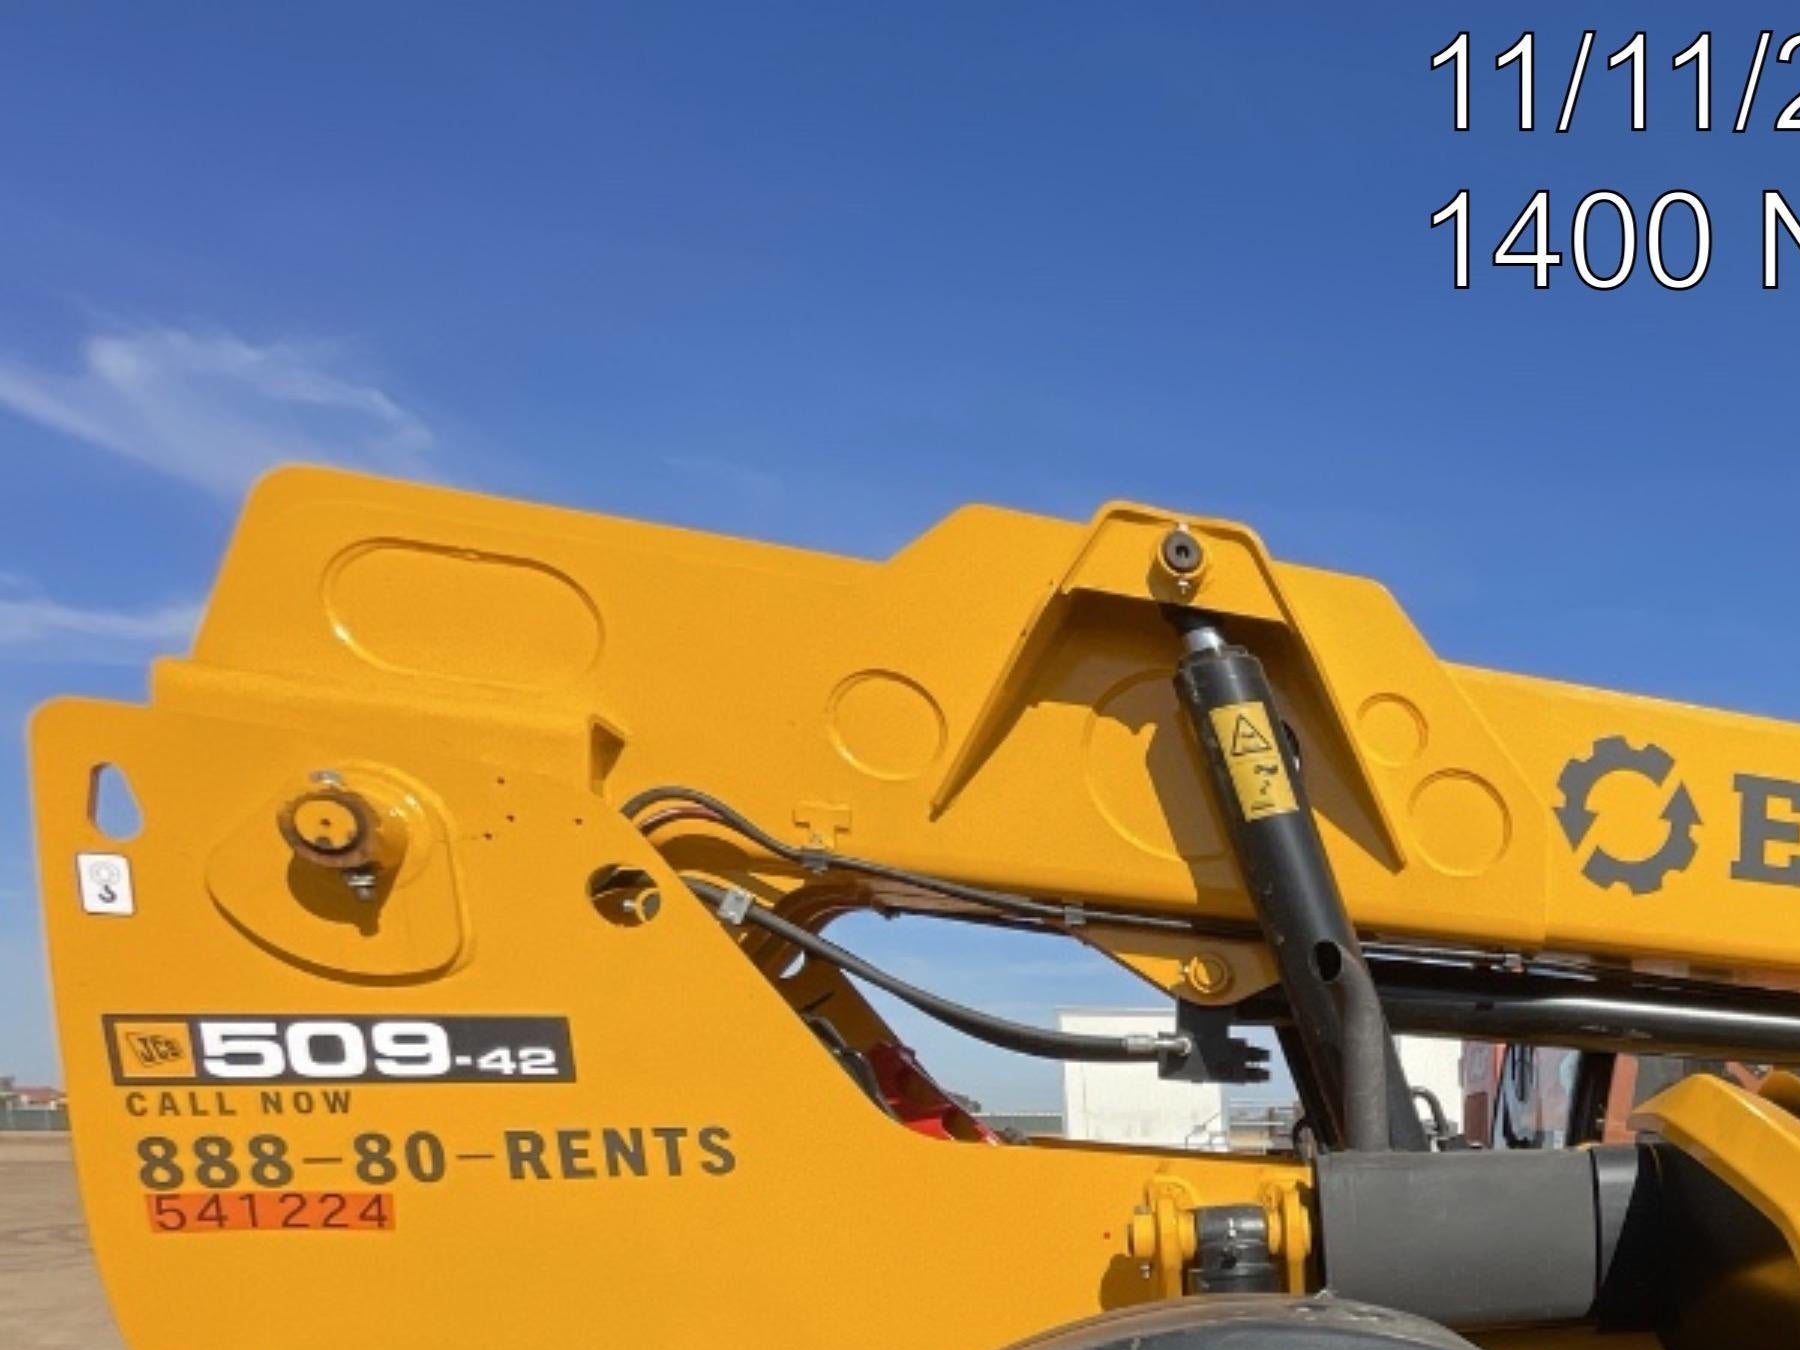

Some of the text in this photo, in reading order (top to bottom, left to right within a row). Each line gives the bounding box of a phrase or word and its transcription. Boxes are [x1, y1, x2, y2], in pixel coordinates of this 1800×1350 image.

[200, 1021, 559, 1078] 509-42
[125, 1090, 354, 1117] CALL NOW
[135, 1126, 738, 1191] 888-80-RENTS
[154, 1193, 389, 1231] 541224
